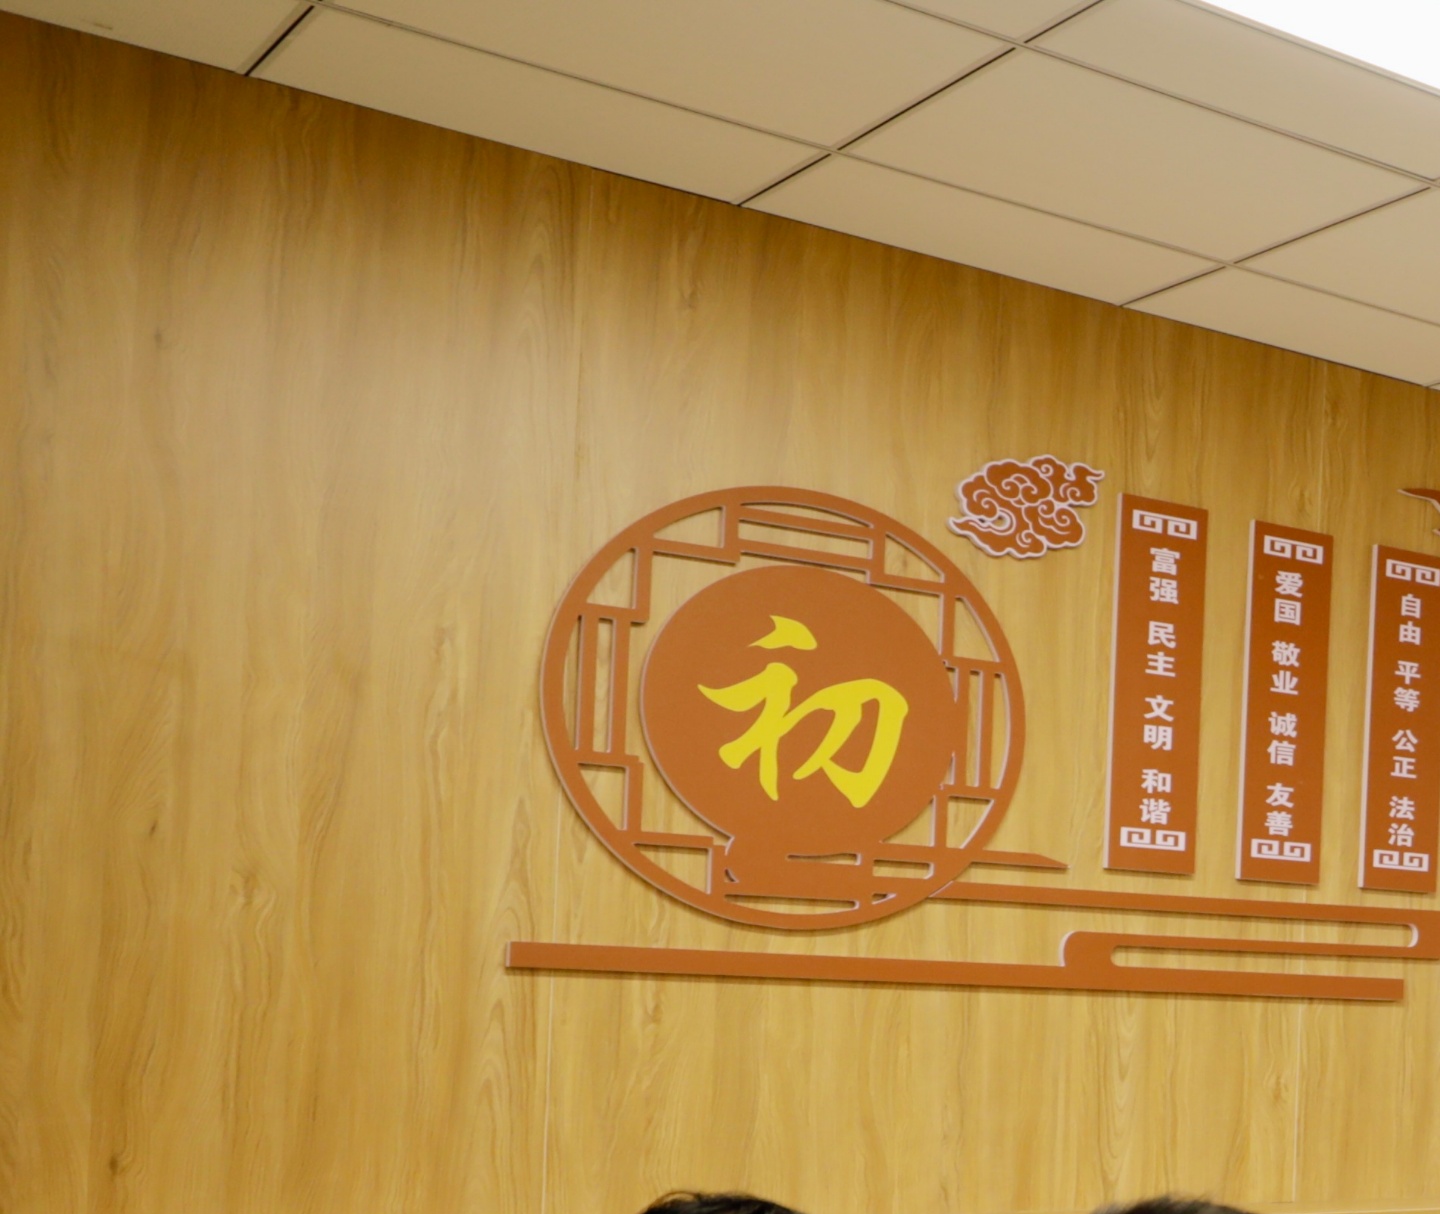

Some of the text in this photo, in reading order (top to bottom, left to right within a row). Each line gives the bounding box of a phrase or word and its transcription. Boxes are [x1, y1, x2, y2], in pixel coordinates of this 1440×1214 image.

[698, 614, 910, 808] 初
[1139, 547, 1181, 825] 富强 民主 文明 和谐
[1264, 571, 1304, 837] 爱国 敬业 诚信 友善
[1387, 594, 1423, 848] 自由 平等 公正 法治
